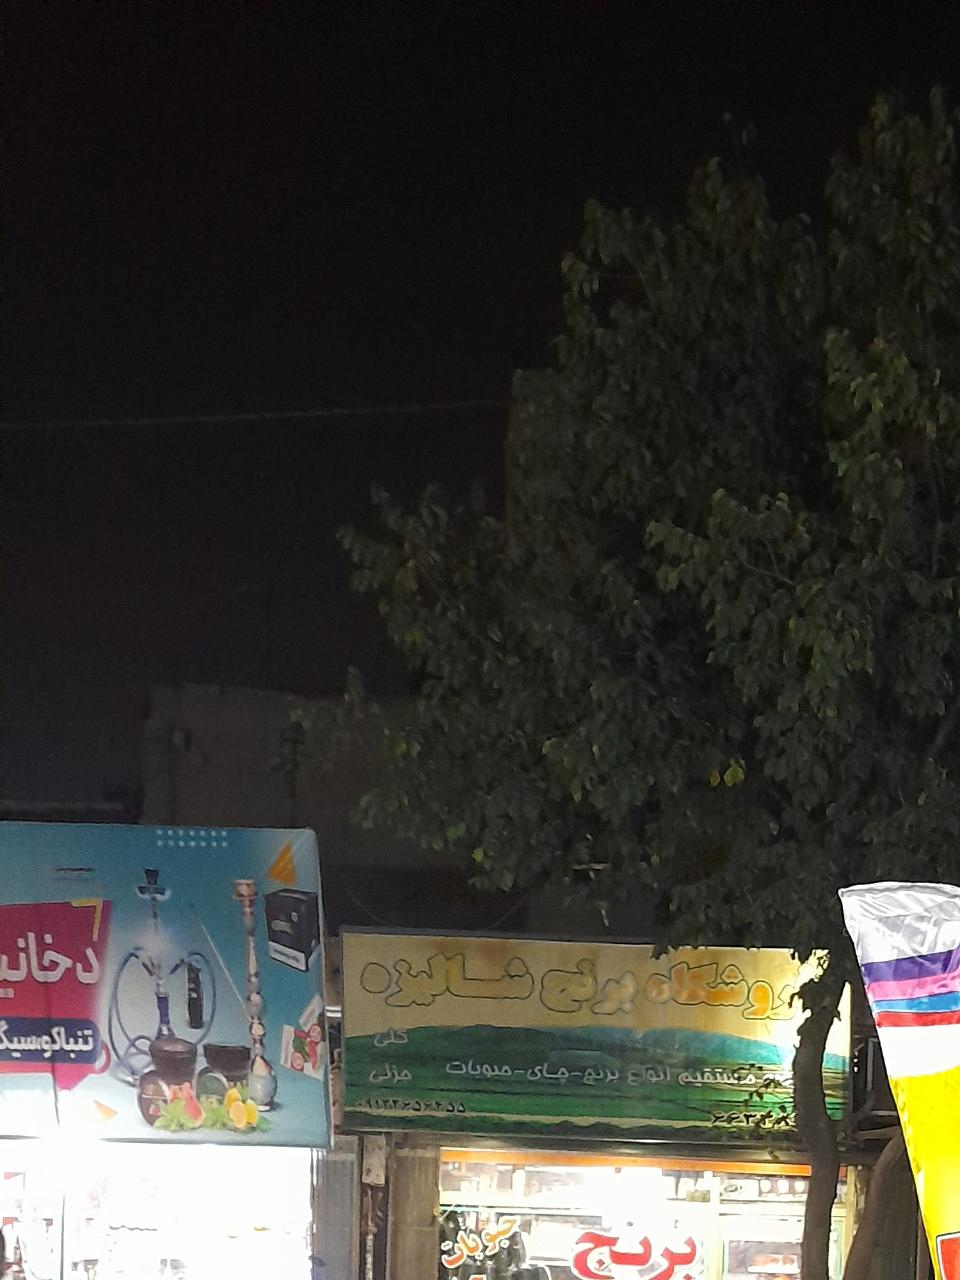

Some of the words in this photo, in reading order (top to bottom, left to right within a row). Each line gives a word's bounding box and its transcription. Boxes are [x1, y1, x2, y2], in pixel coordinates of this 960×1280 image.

[0, 932, 99, 998] دخانی
[540, 958, 638, 1015] برنج
[644, 961, 800, 1021] روشگاه
[0, 1020, 42, 1058] سیگ
[374, 1028, 409, 1047] کلی
[441, 1216, 519, 1268] حبوبات
